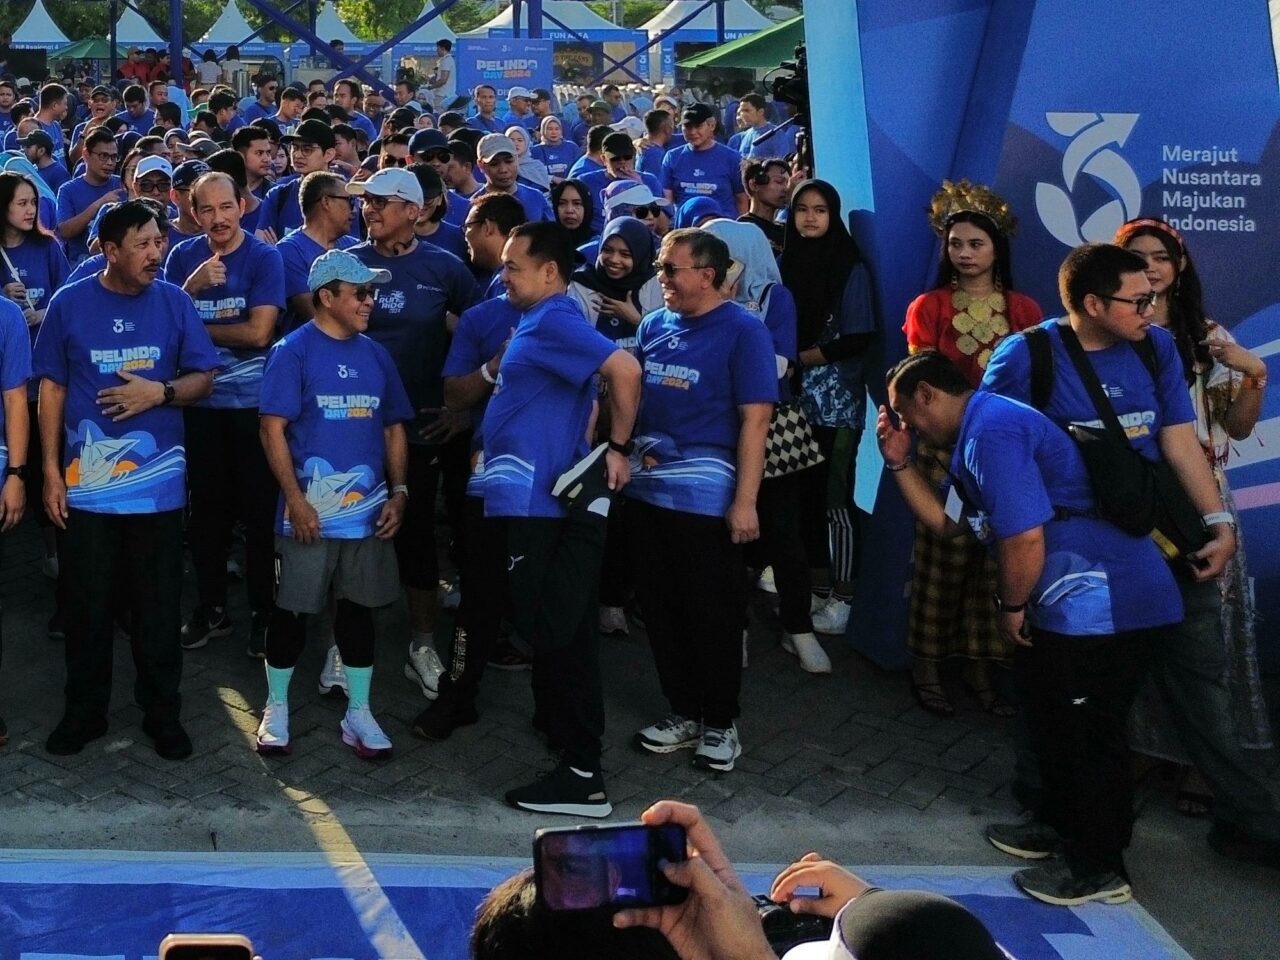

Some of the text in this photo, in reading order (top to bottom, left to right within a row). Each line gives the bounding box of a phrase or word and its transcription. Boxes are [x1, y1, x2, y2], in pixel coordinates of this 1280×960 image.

[476, 59, 538, 71] PELINDO
[1162, 145, 1238, 166] Merajut
[1162, 168, 1262, 187] Nusantara
[1162, 191, 1246, 209] Majukan
[90, 346, 160, 363] PELINDO
[643, 360, 699, 385] PELINDO
[315, 394, 380, 409] PELINDO
